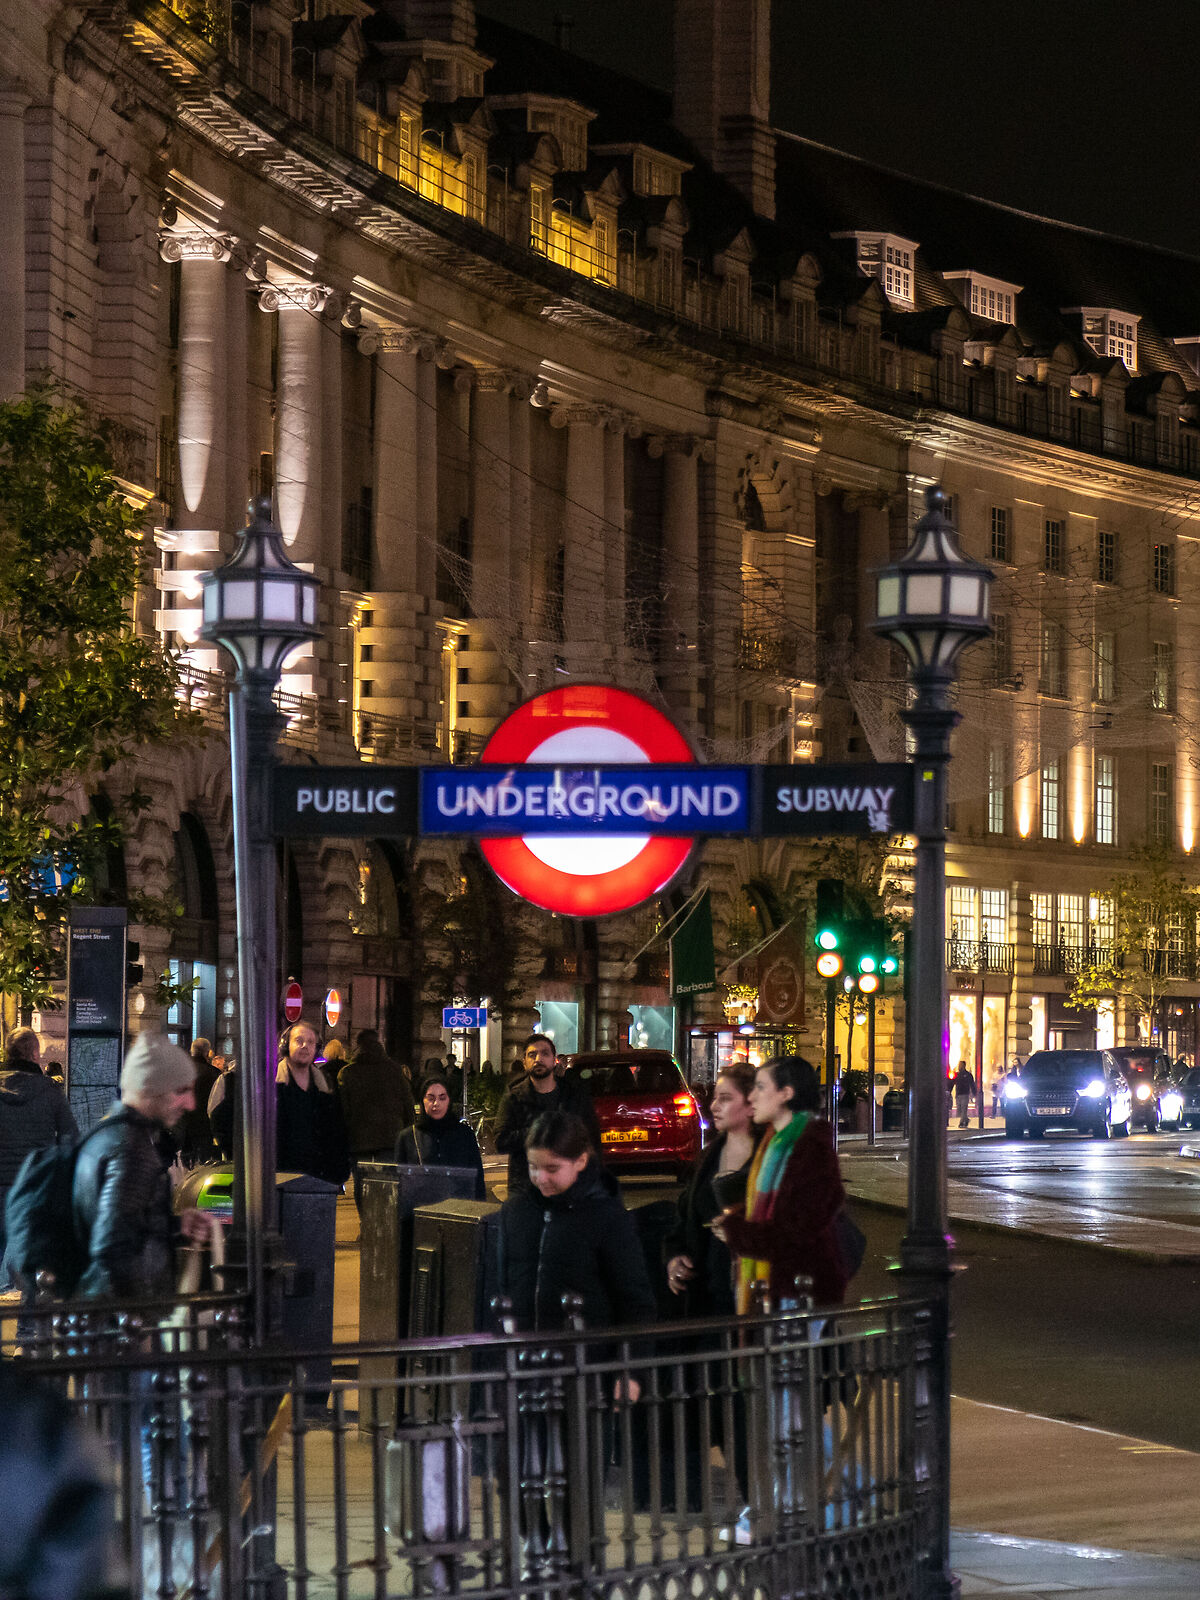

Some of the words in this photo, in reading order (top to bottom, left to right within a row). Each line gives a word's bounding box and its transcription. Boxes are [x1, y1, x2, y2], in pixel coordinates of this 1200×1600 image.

[296, 788, 396, 814] PUBLIC
[437, 785, 739, 817] UNDERGROUND
[776, 786, 894, 814] SUBWAY
[676, 981, 714, 994] Barbour
